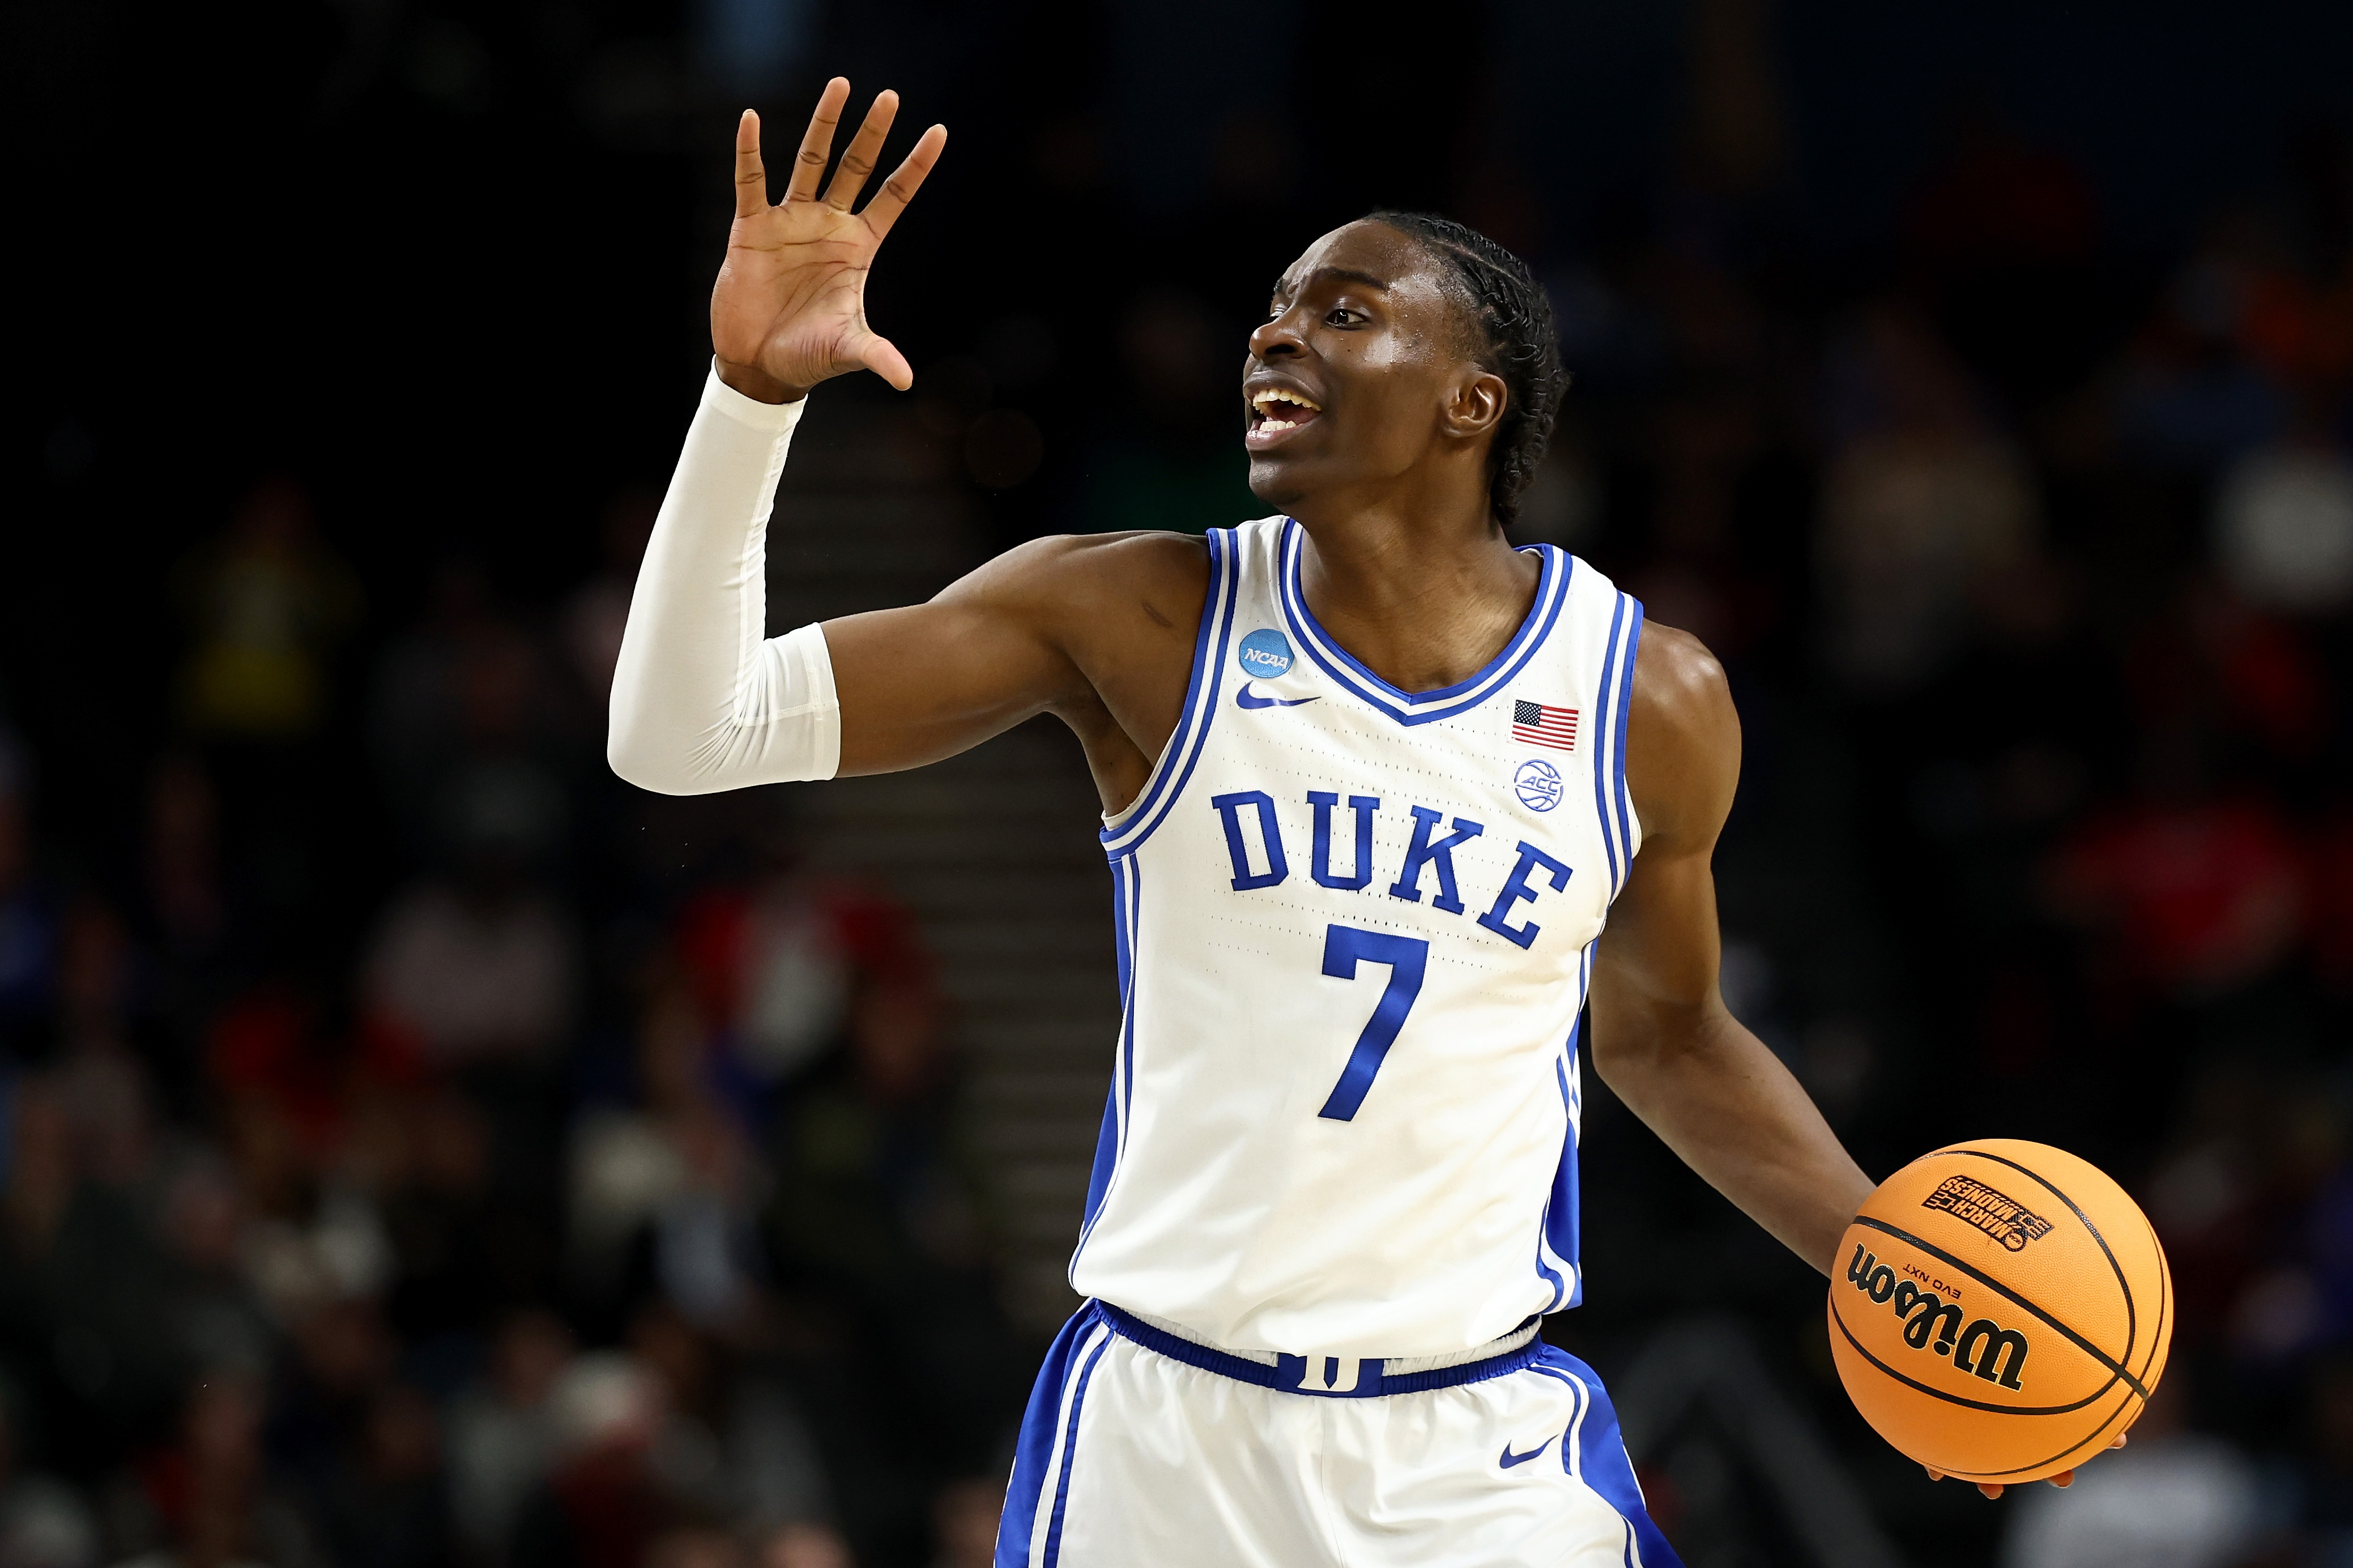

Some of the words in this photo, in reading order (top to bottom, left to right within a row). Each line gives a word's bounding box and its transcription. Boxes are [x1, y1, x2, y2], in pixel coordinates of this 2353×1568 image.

[1244, 648, 1289, 669] NCAA
[1521, 776, 1562, 792] ACC
[1212, 791, 1573, 950] DUKE
[1317, 924, 1430, 1122] 7
[1940, 1178, 2018, 1221] MADNESS
[1950, 1199, 2011, 1238] MARCH
[1903, 1263, 1930, 1283] NXT
[1932, 1279, 1962, 1300] EVO
[1846, 1243, 2029, 1393] Wilson
